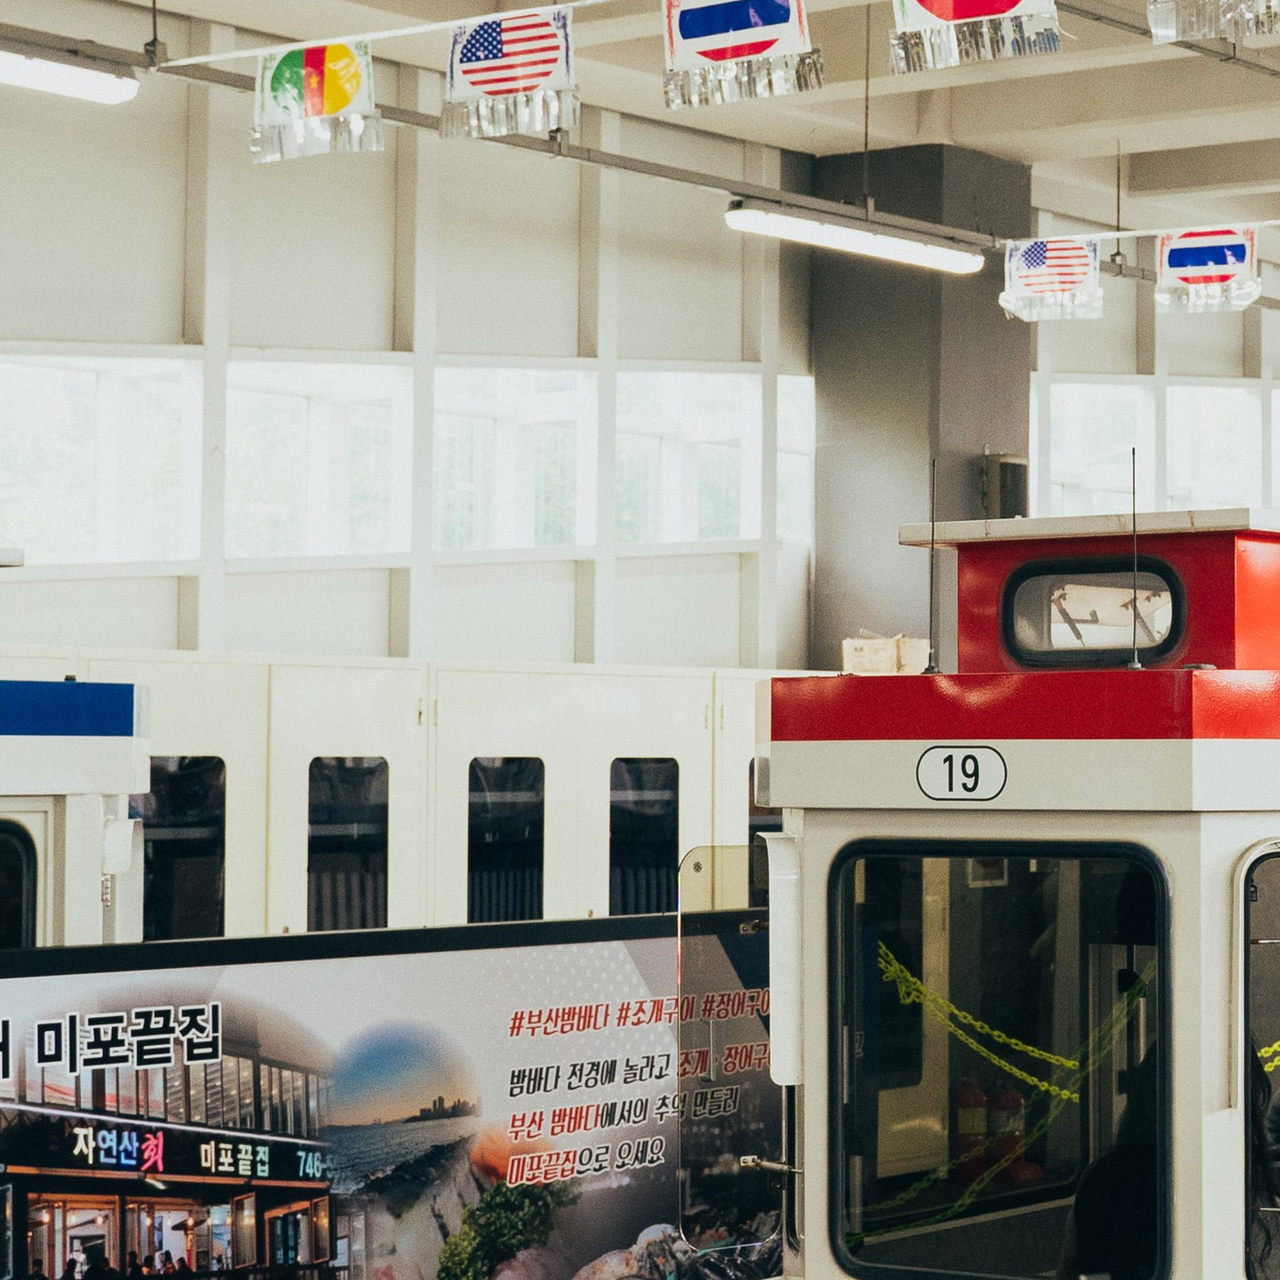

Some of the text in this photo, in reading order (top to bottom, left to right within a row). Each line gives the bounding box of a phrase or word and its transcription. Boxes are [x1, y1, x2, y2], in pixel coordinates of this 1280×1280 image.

[943, 753, 980, 793] 19
[36, 1003, 220, 1074] 미포끝집
[509, 1004, 610, 1037] #부산밤바다
[616, 996, 695, 1028] #조개구이
[509, 1065, 561, 1097] 밤바다
[567, 1059, 618, 1091] 전경에
[623, 1053, 671, 1084] 놀라고
[677, 1049, 709, 1077] 조개
[509, 1111, 544, 1140] 부산
[550, 1098, 649, 1136] 밤바다에서의
[655, 1092, 688, 1122] 추억
[200, 1140, 270, 1178] 미포끝집
[508, 1138, 665, 1185] 미포끝집으로 오세요
